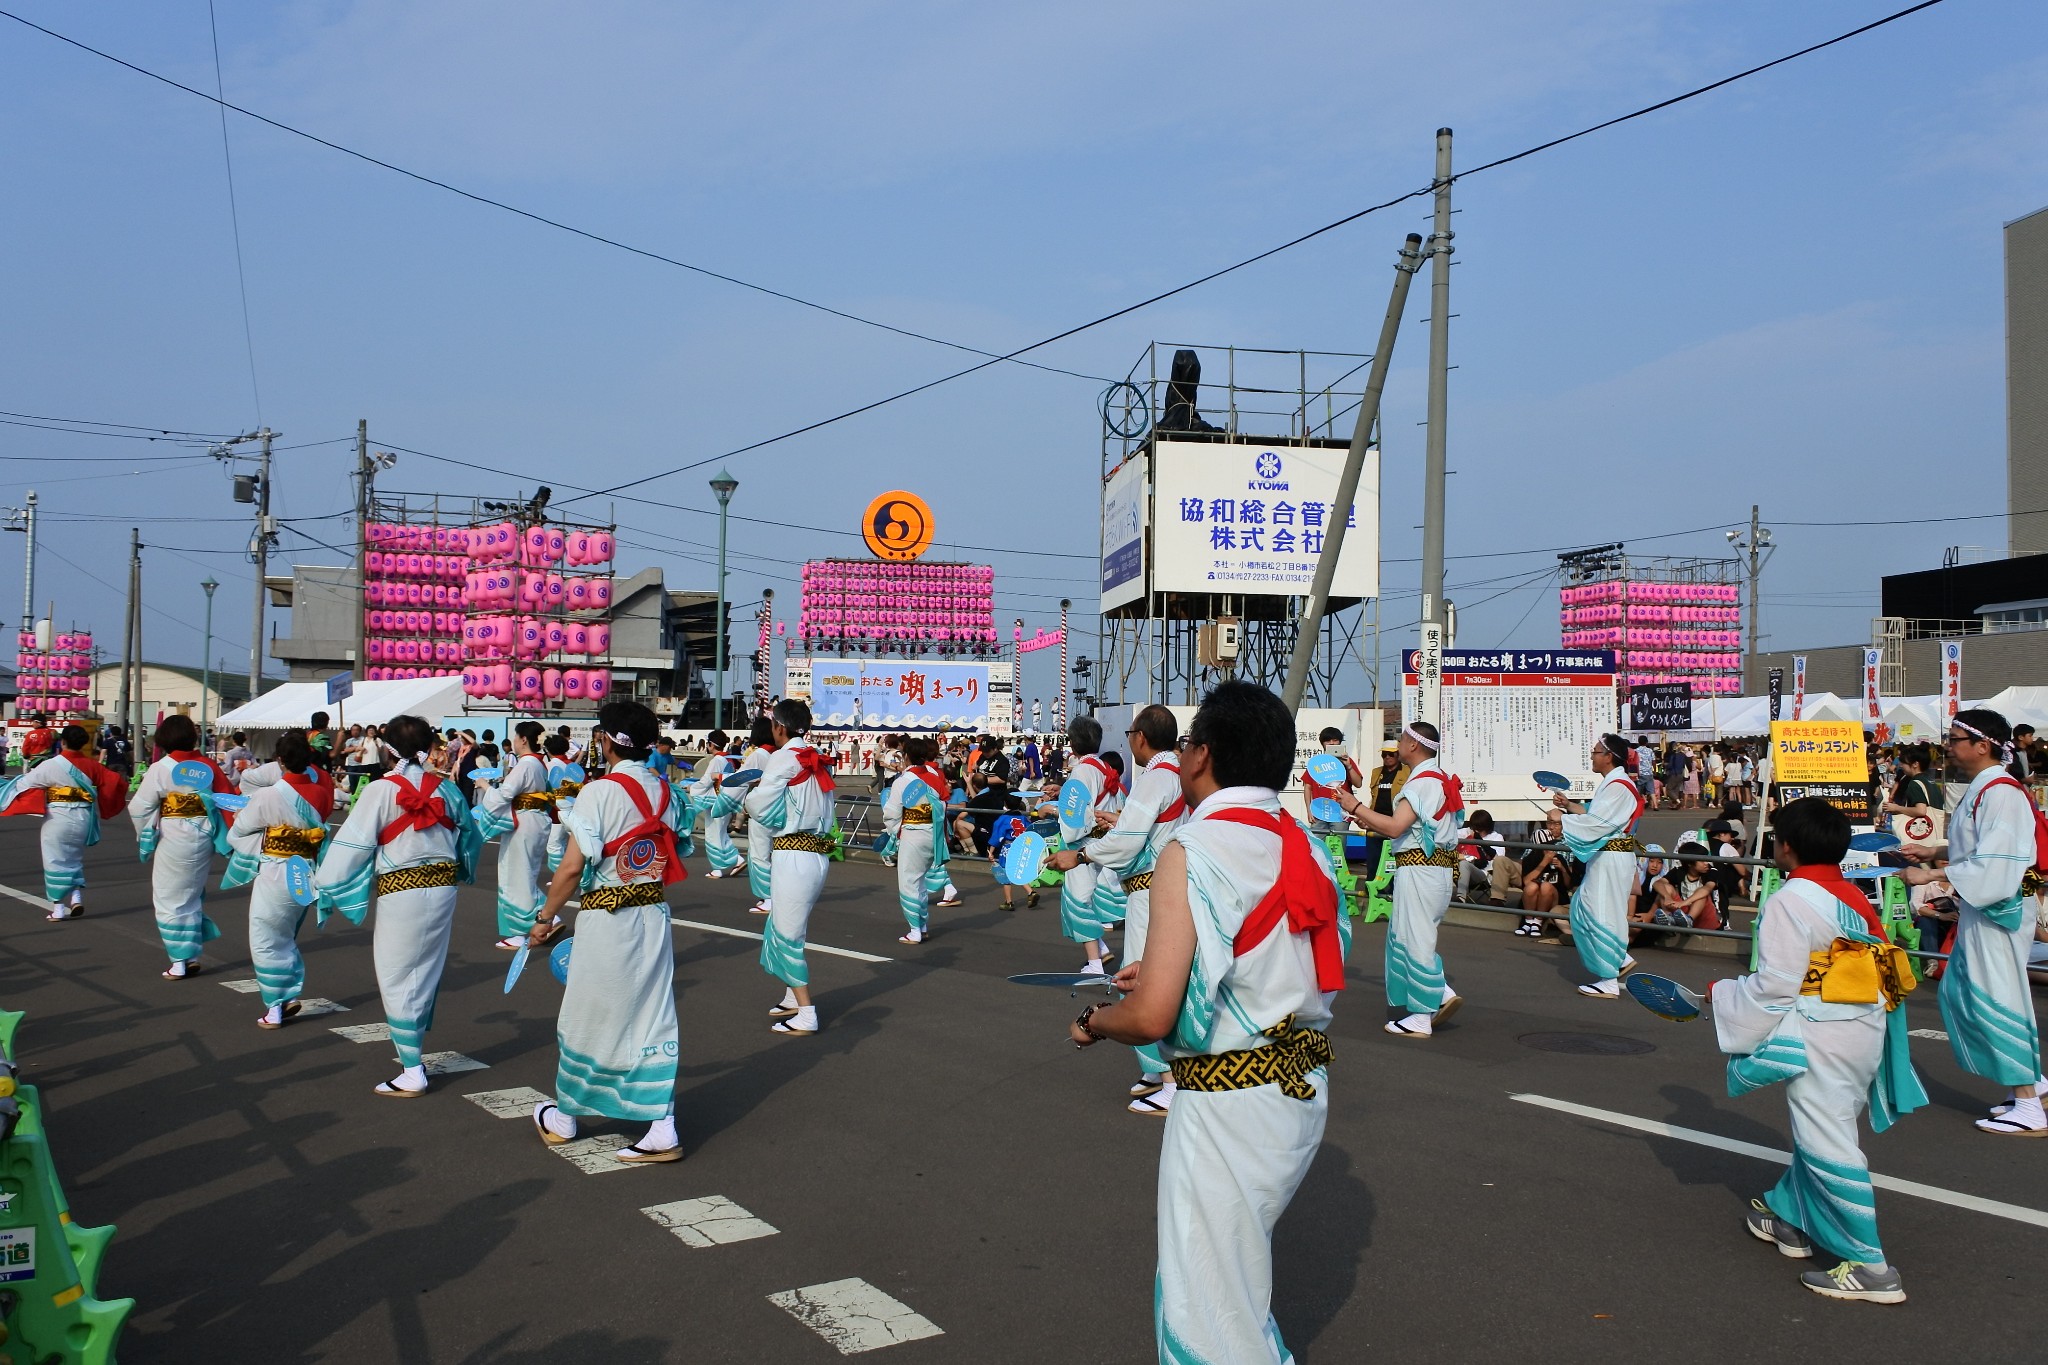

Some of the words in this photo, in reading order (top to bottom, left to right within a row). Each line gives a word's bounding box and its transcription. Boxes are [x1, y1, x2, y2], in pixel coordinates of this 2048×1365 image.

[1248, 480, 1289, 491] KYOWA
[1210, 526, 1325, 554] 株式会社
[1441, 656, 1465, 667] 50回
[1468, 657, 1499, 668] おたる
[1556, 656, 1603, 668] 行事案内板
[860, 676, 894, 687] おたる
[1674, 696, 1688, 709] Bar
[1780, 740, 1860, 753] うしおキッズランド
